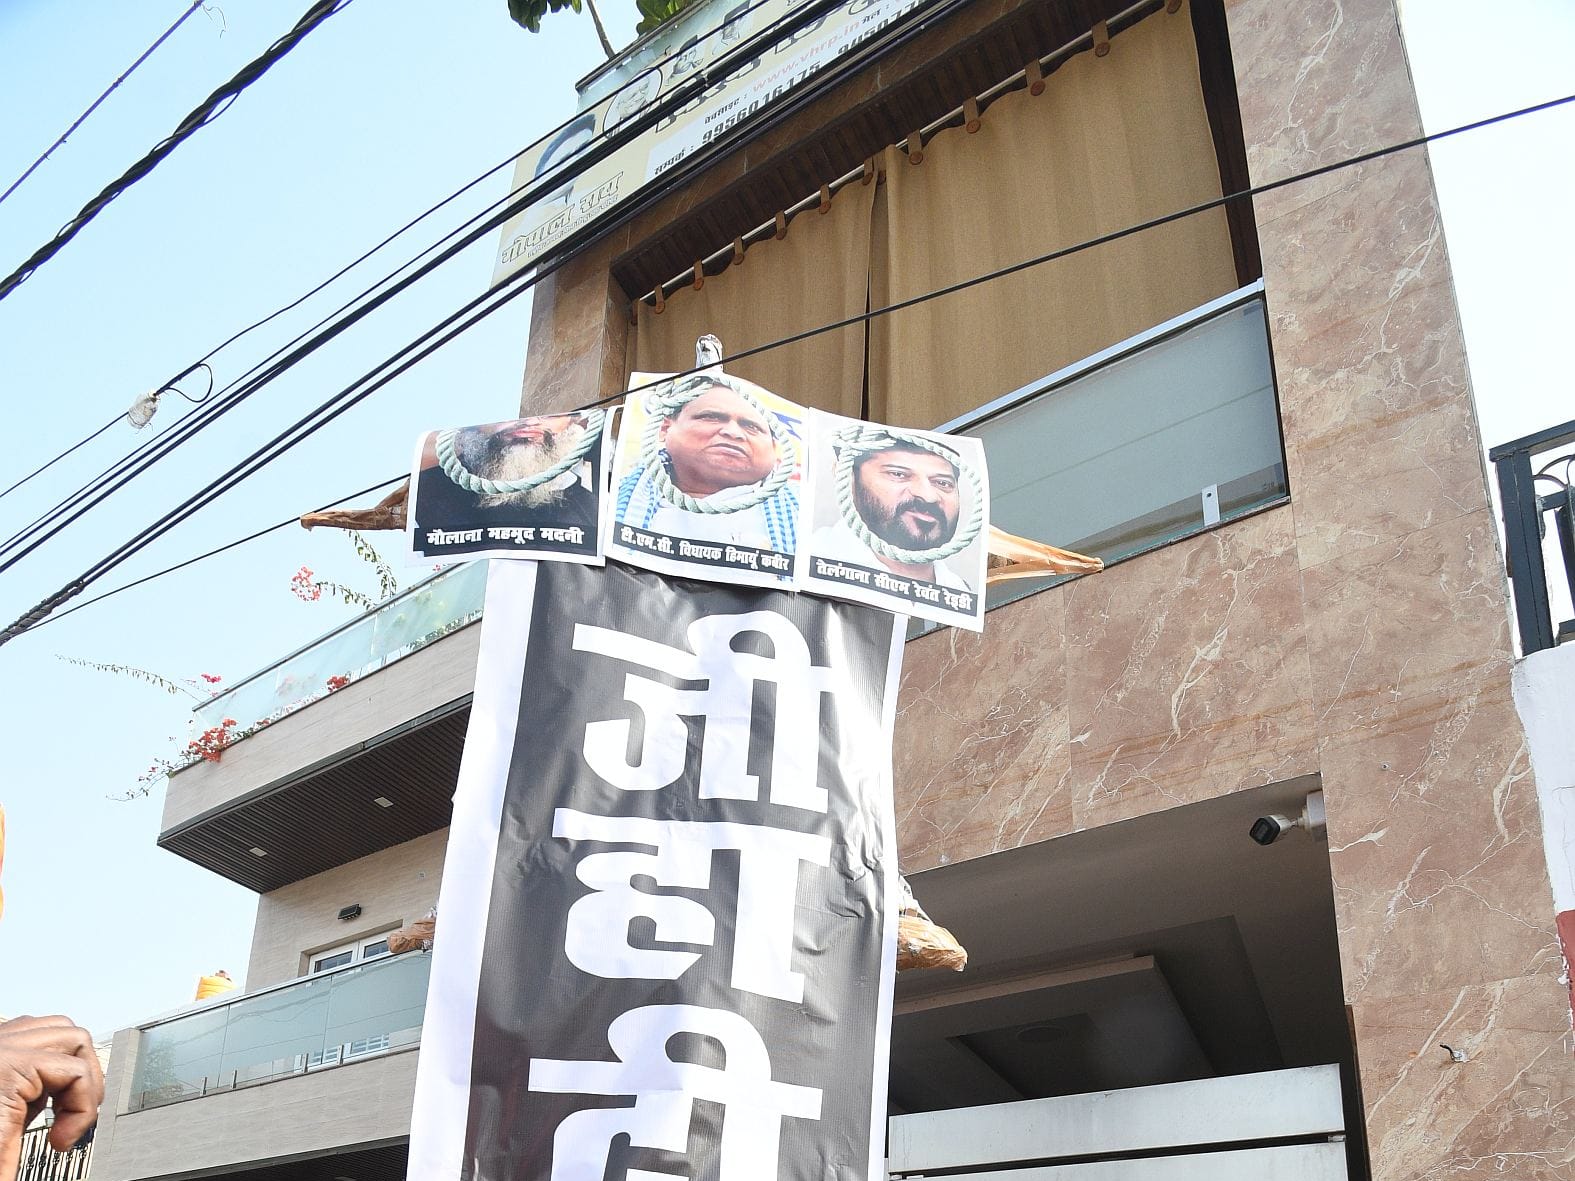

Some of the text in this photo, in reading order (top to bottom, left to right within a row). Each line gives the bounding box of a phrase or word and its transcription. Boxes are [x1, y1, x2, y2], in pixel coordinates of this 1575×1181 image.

[427, 526, 585, 546] मौलाना महमूद मदनी
[620, 525, 675, 554] टी.एम.सी.
[725, 545, 760, 570] हिमायूं
[760, 553, 791, 571] कबीर
[816, 558, 973, 611] तेलंगाना सीएम रेवंत रेड्डी
